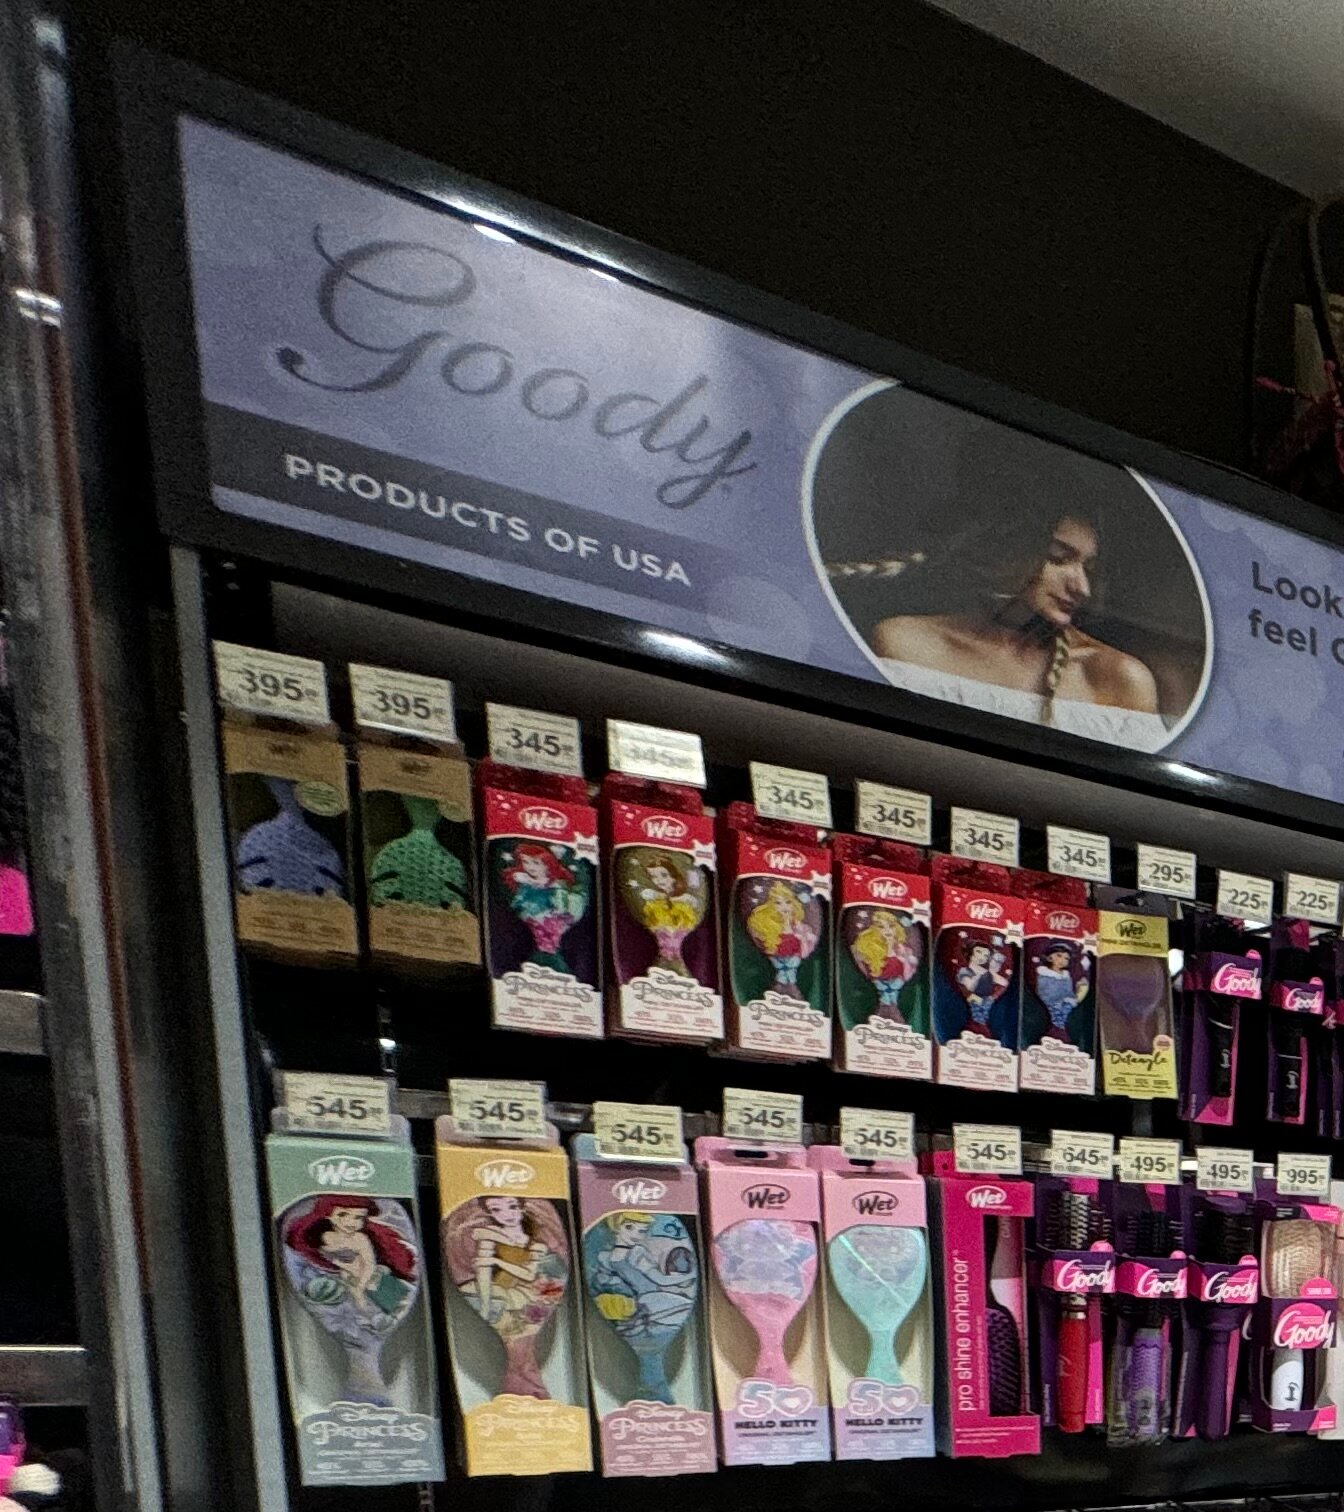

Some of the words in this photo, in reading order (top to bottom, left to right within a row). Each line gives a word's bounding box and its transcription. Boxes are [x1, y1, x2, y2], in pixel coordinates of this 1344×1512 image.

[276, 222, 758, 510] Goody
[283, 452, 532, 545] PRODUCTS
[546, 525, 601, 563] OF
[612, 541, 694, 589] USA
[1251, 562, 1344, 618] Look
[1249, 608, 1319, 657] feel
[1274, 1309, 1335, 1349] Goody
